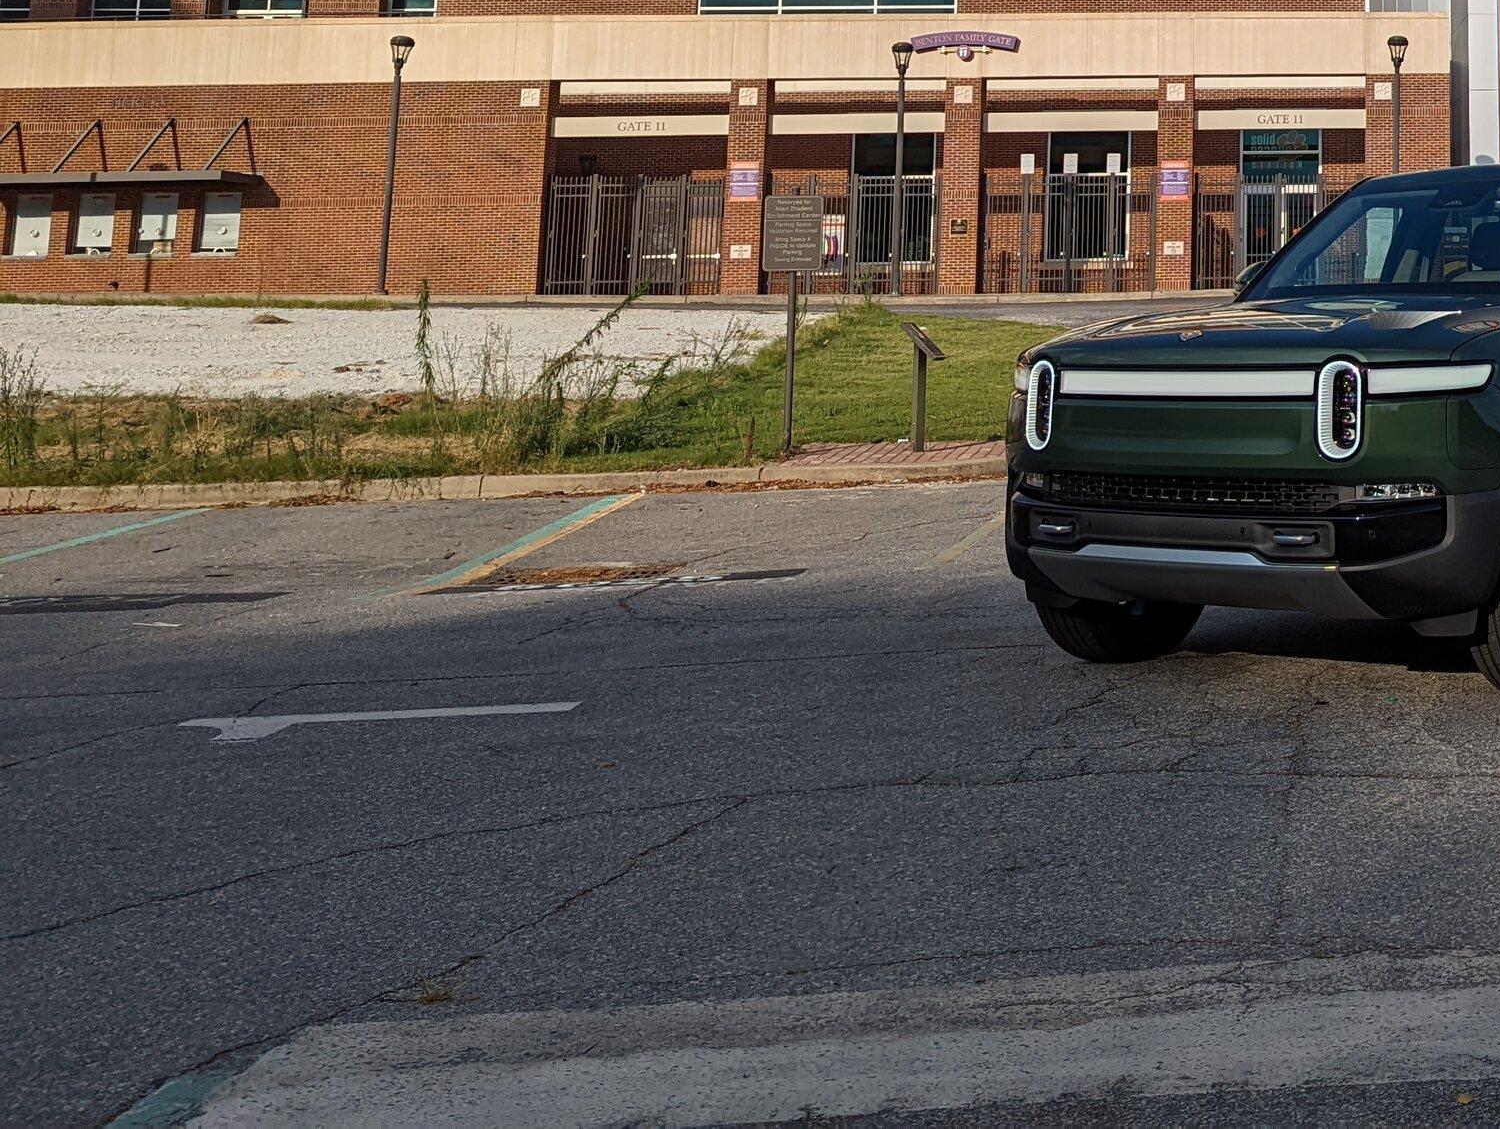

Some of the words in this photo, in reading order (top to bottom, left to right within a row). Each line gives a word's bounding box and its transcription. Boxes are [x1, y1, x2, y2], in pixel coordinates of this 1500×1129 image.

[914, 35, 953, 46] BENTON
[954, 33, 987, 42] FAMILY
[988, 35, 1012, 46] GATE
[1257, 114, 1290, 124] GATE
[1293, 115, 1304, 124] 11
[617, 121, 652, 132] GATE
[655, 121, 667, 131] 11
[1250, 133, 1276, 145] solid
